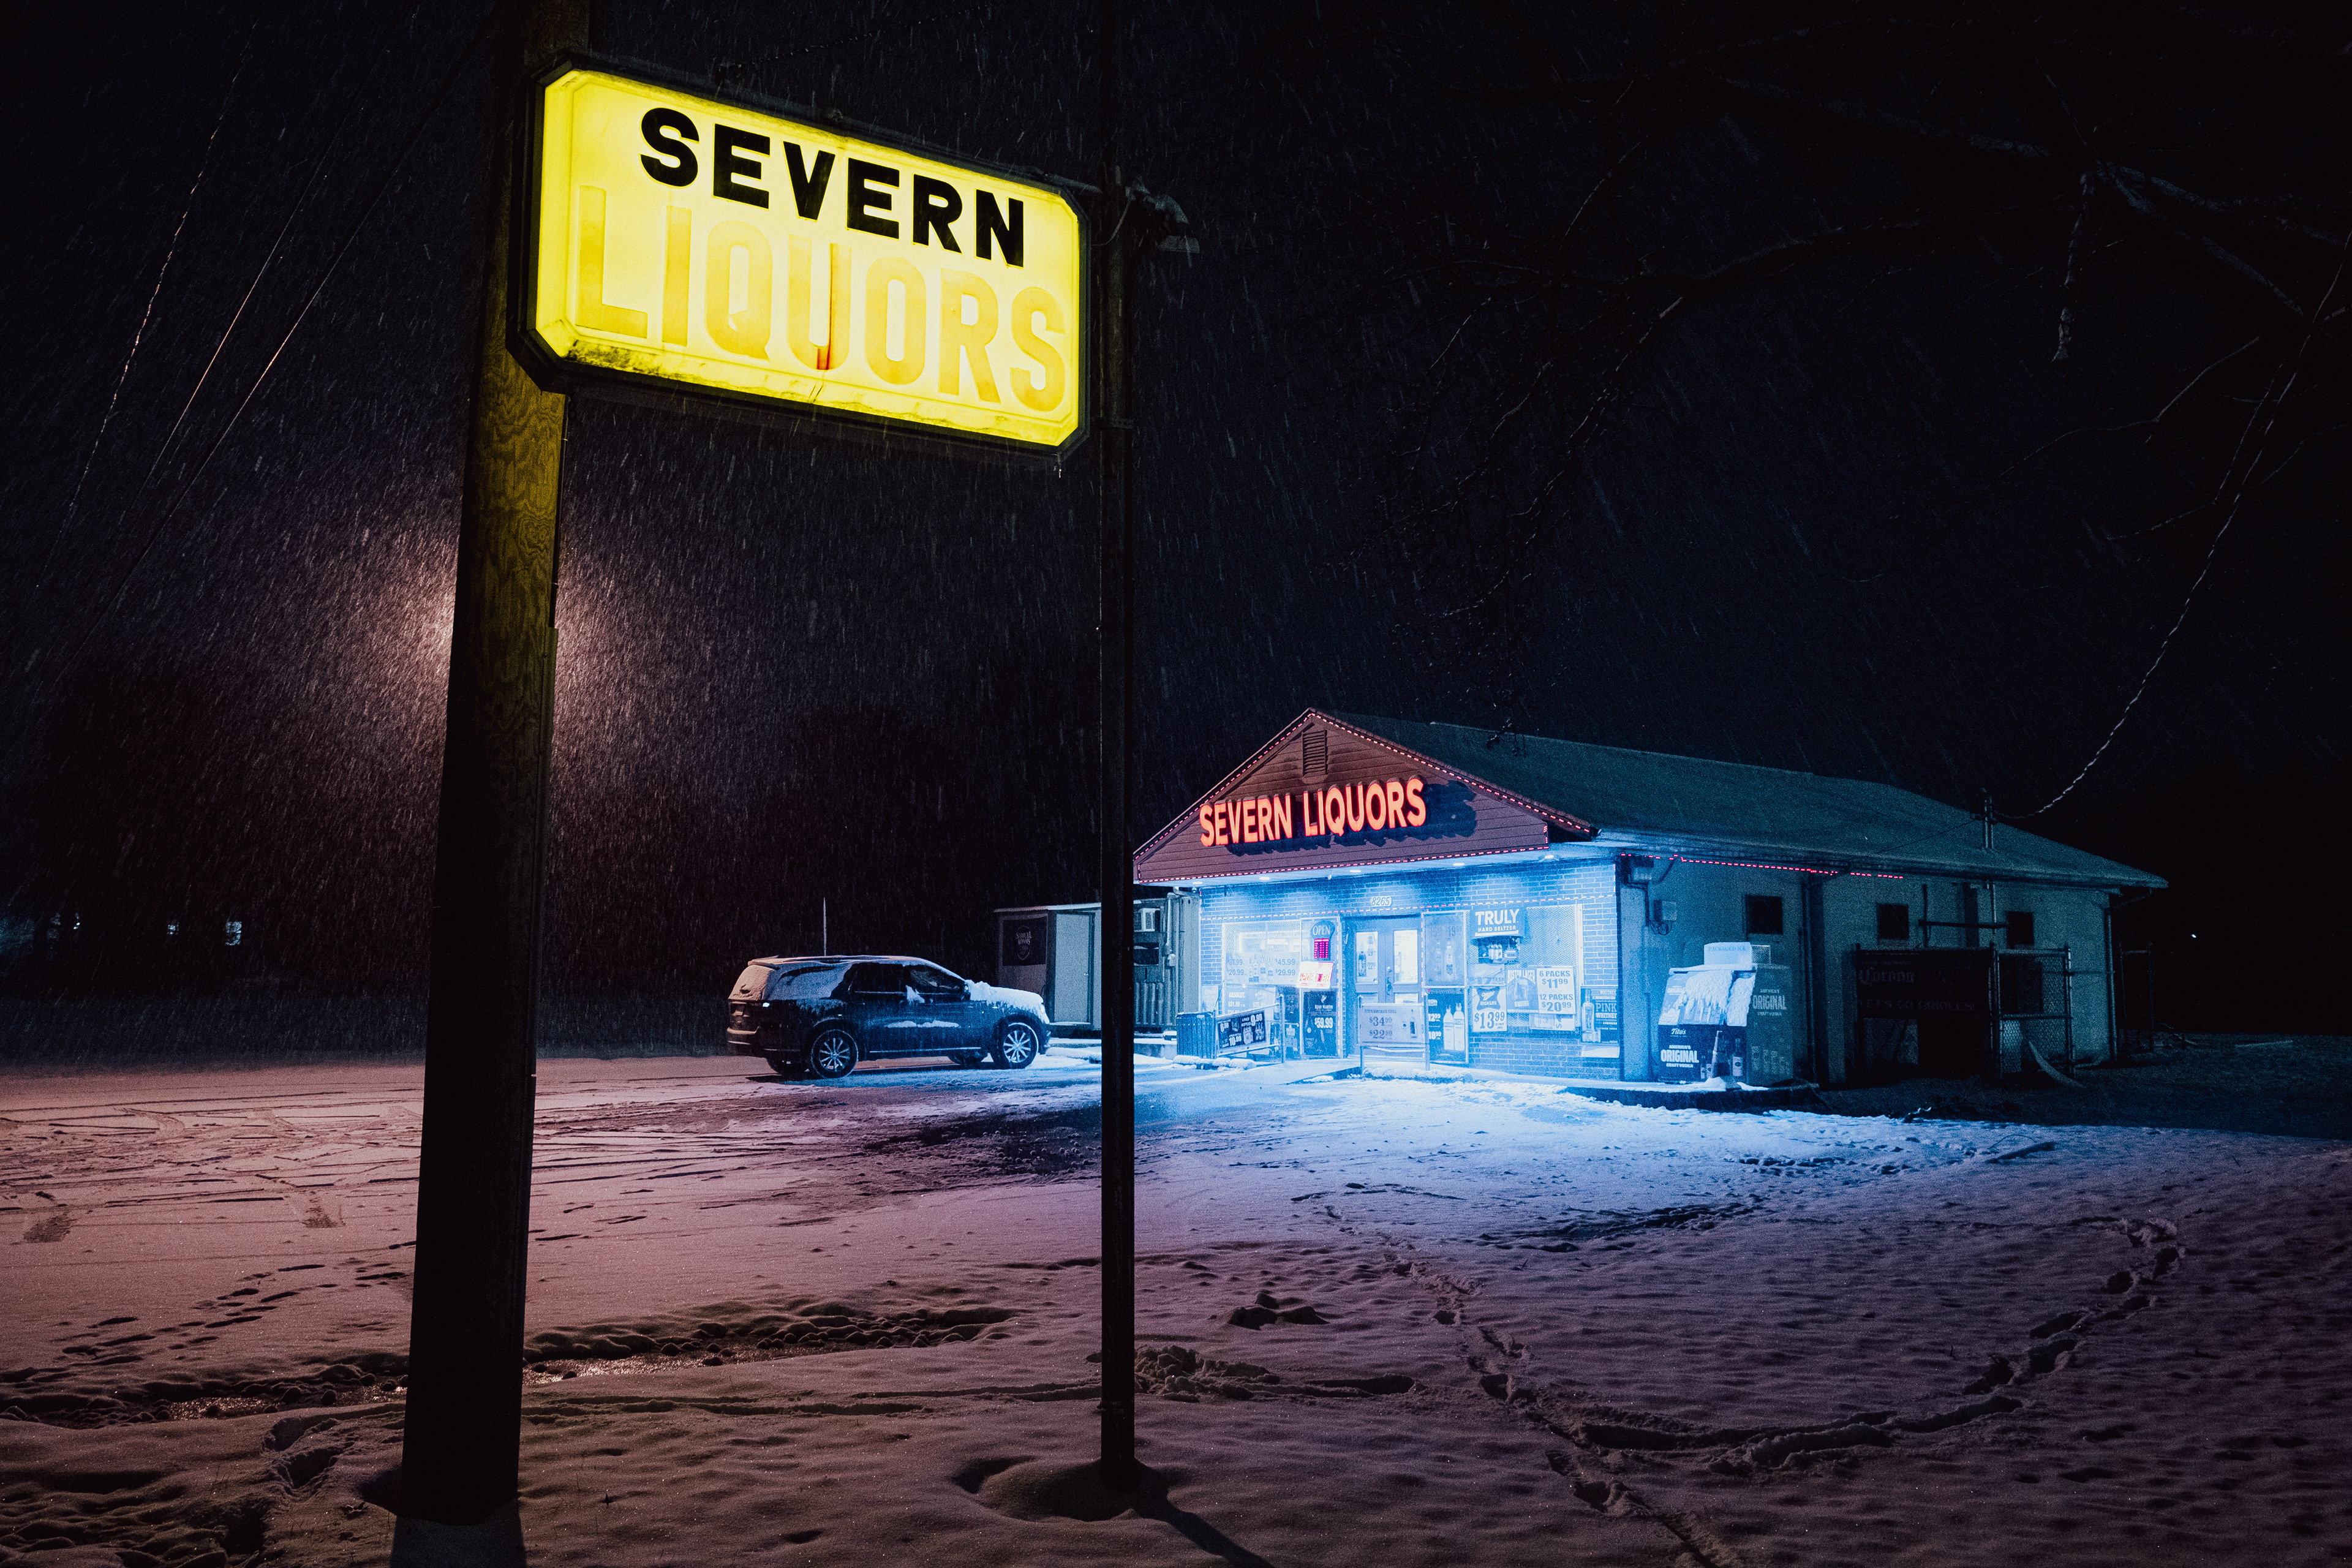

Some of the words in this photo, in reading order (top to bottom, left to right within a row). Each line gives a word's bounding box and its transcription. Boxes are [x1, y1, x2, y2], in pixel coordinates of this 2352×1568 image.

[639, 107, 1025, 268] SEVERN
[576, 185, 1066, 412] LIQUORS
[1199, 794, 1293, 847] SEVERN
[1303, 777, 1427, 837] LIQUORS
[1371, 896, 1390, 906] 8265
[1312, 925, 1331, 935] OPEN
[1859, 966, 1915, 987] Corona
[1596, 1003, 1618, 1012] PINK
[1752, 995, 1787, 1010] ORIGINAL
[1314, 1017, 1333, 1028] $59.99
[1660, 1049, 1700, 1063] ORIGINAL
